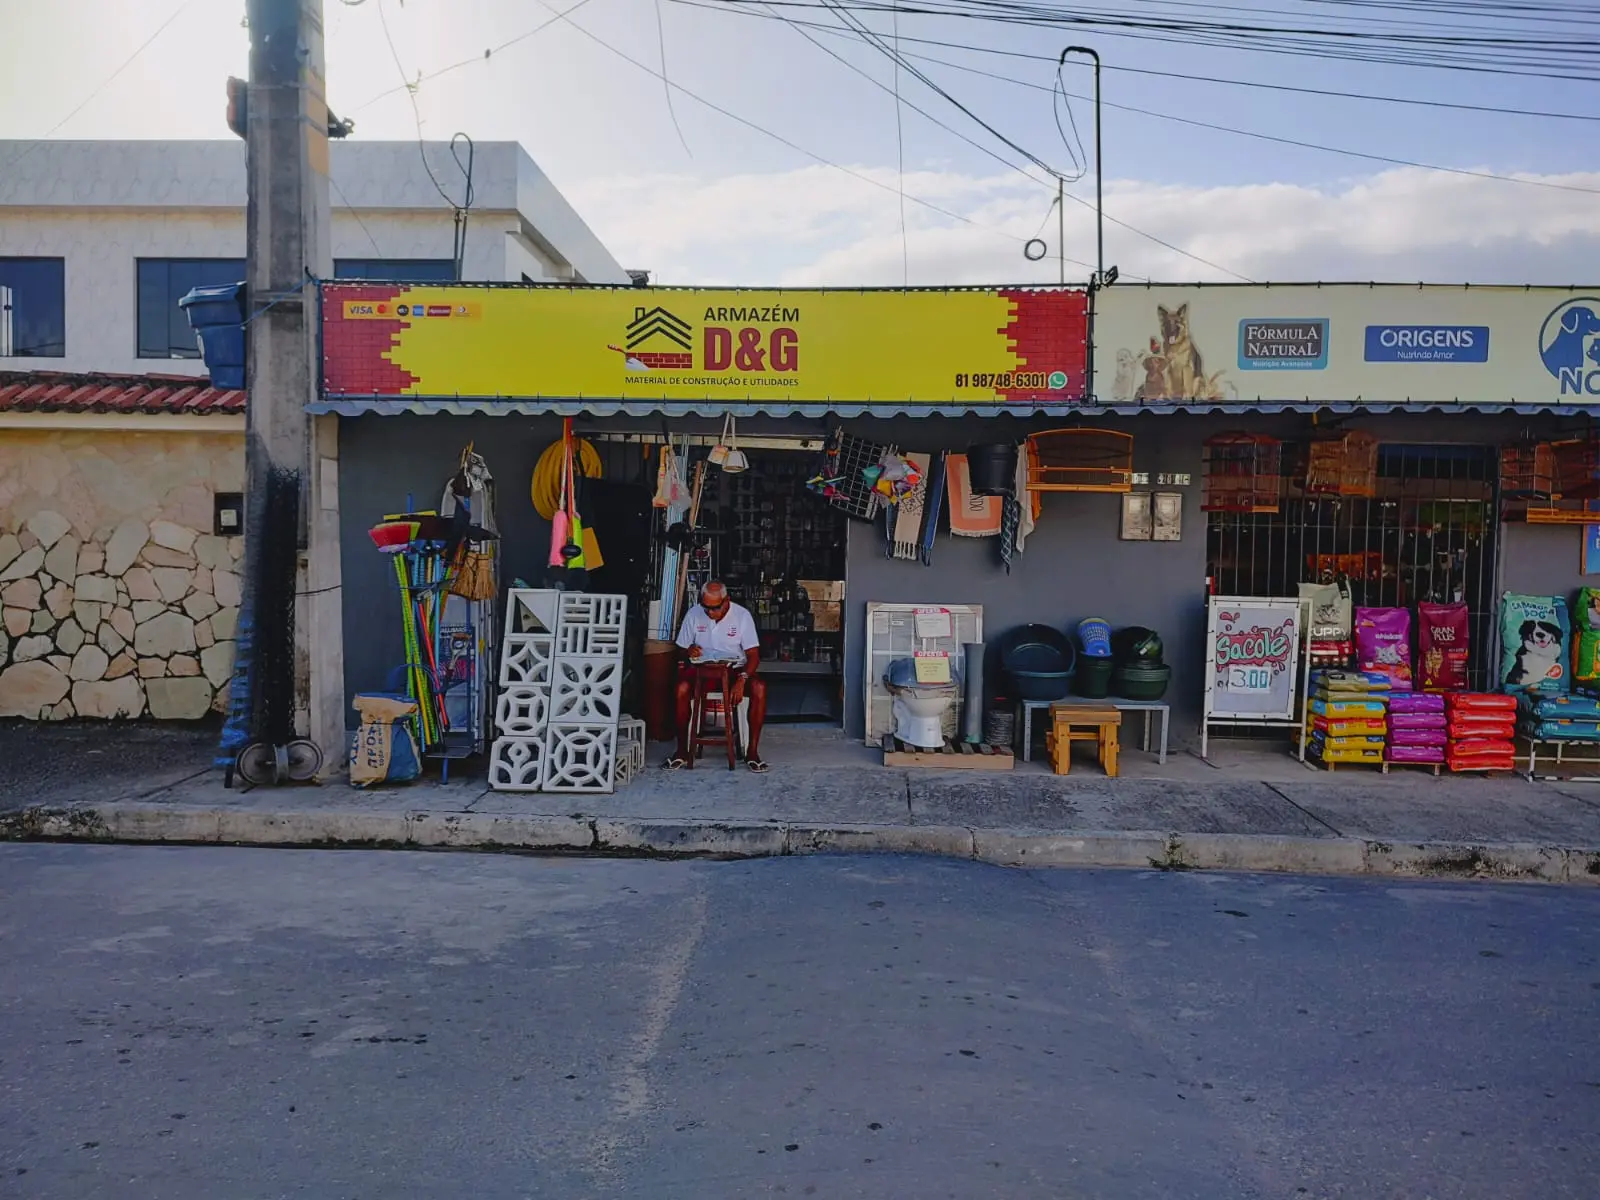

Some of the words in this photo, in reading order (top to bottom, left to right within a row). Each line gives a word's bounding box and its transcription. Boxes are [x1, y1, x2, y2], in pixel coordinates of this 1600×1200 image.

[350, 306, 374, 315] VISA
[704, 304, 799, 322] ARMAZÉM
[1247, 326, 1318, 340] FÓRMULA
[1380, 329, 1474, 347] ORIGENS
[703, 327, 799, 372] D&G
[1247, 342, 1318, 356] NATURAL
[1397, 351, 1432, 359] Nutrindo
[1433, 351, 1454, 359] Amor
[625, 376, 667, 385] MATERIAL
[669, 377, 681, 385] DE
[682, 376, 741, 387] CONSTRUÇÃO
[743, 378, 749, 386] E
[750, 378, 799, 387] UTILIDADES
[956, 373, 969, 387] 81
[972, 373, 1045, 388] 98748-6301
[1216, 626, 1290, 665] Sacolé
